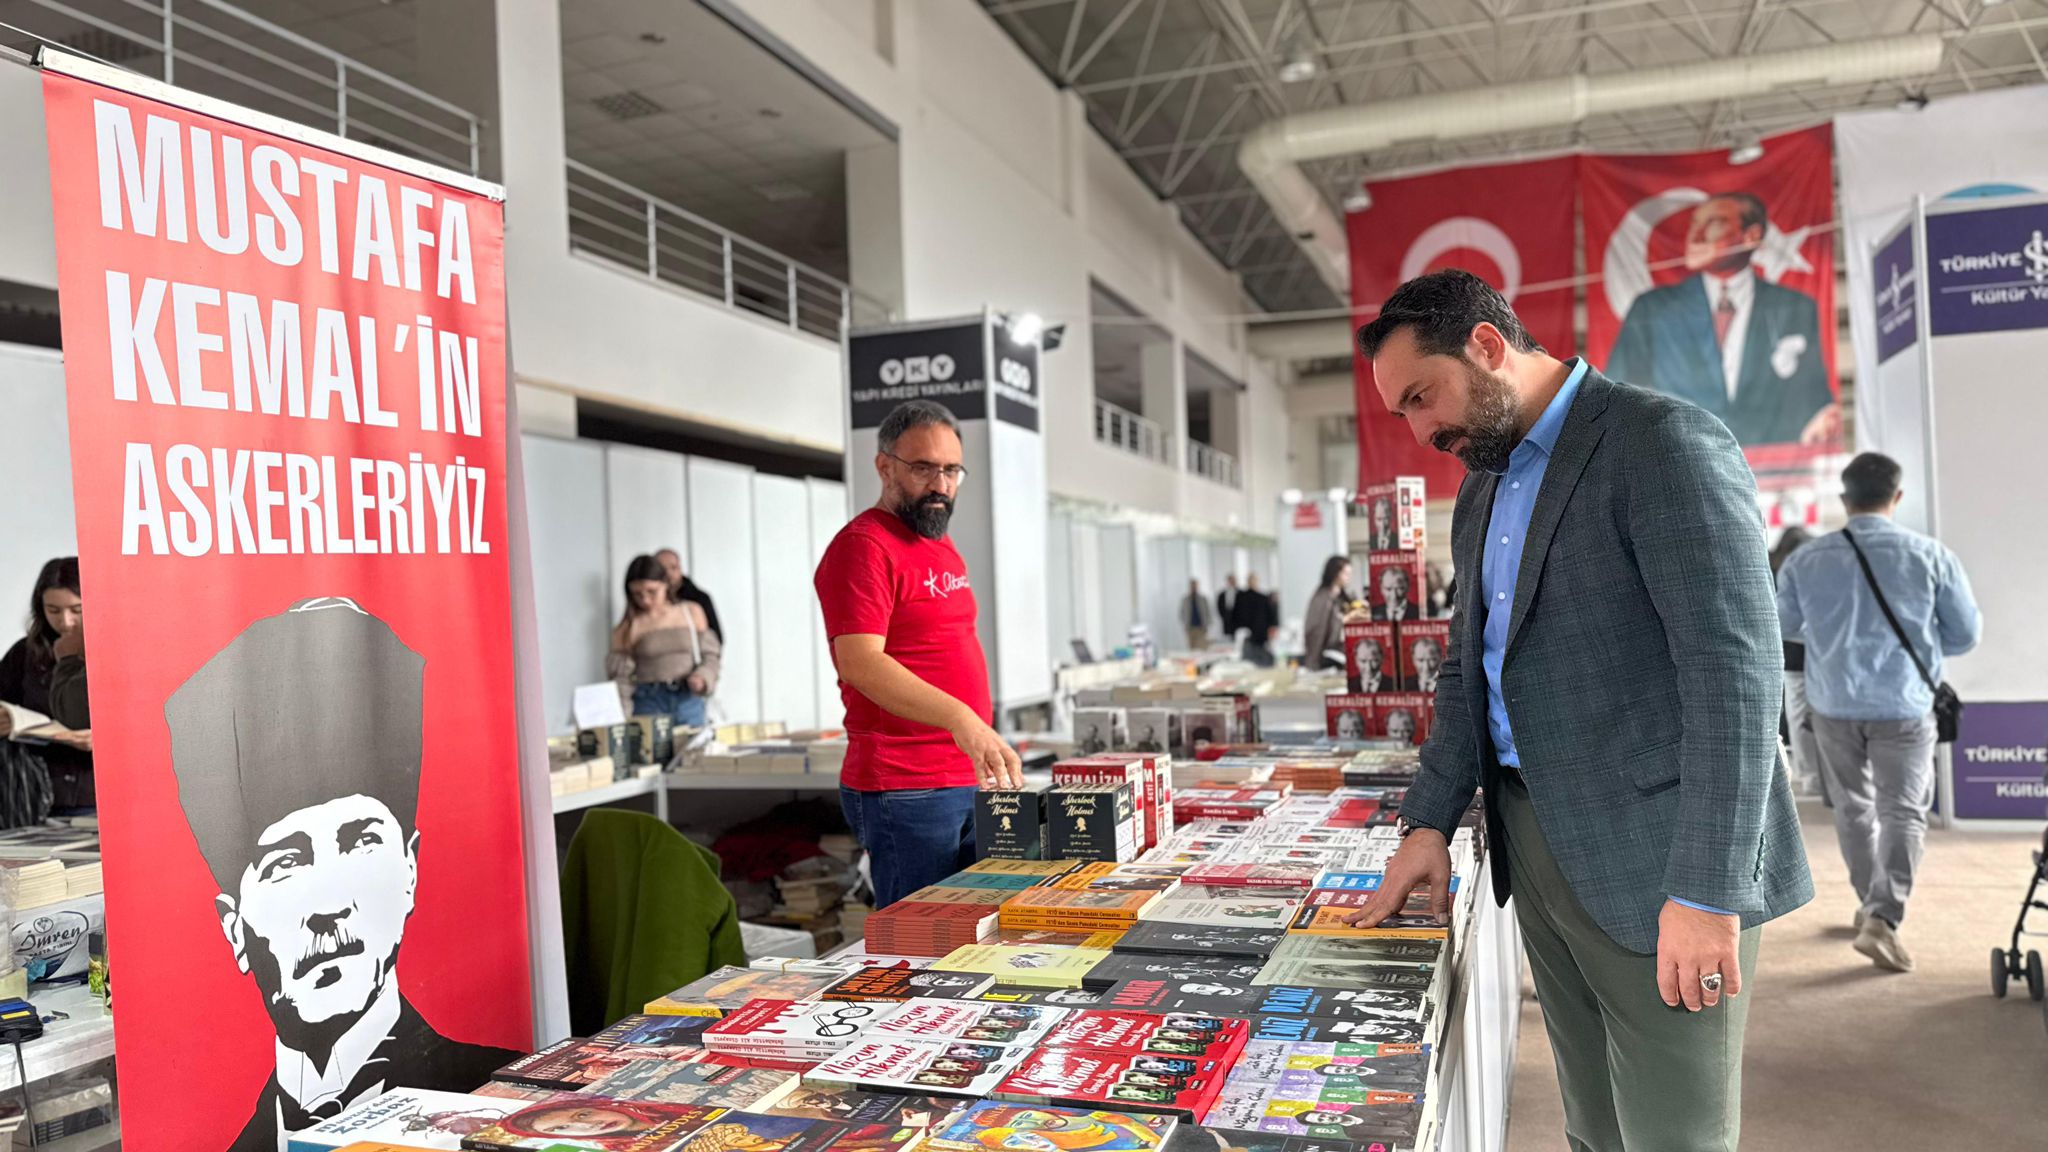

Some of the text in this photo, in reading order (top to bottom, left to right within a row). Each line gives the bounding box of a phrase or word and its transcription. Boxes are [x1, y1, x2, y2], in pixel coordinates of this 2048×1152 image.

[94, 98, 477, 305] MUSTAFA
[1939, 252, 2022, 273] TÜRKİYE
[1970, 287, 2027, 306] Kültür
[105, 270, 482, 437] KEMAL'İN
[852, 379, 988, 401] YAPI KREDİ YAYINLARI
[121, 441, 491, 556] ASKERLERİYİZ
[1964, 744, 2047, 762] TÜRKİYE
[1054, 770, 1125, 785] KEMALİZM
[986, 793, 1022, 808] Sherlock
[992, 804, 1019, 816] Holmes
[1061, 794, 1098, 809] Sherlock
[1066, 805, 1095, 817] Holmes
[701, 1009, 716, 1017] CHE
[911, 1005, 963, 1035] Hikmet
[1091, 1017, 1136, 1048] Hikmet
[818, 1042, 883, 1076] Nâzım
[852, 1044, 917, 1079] Hikmet
